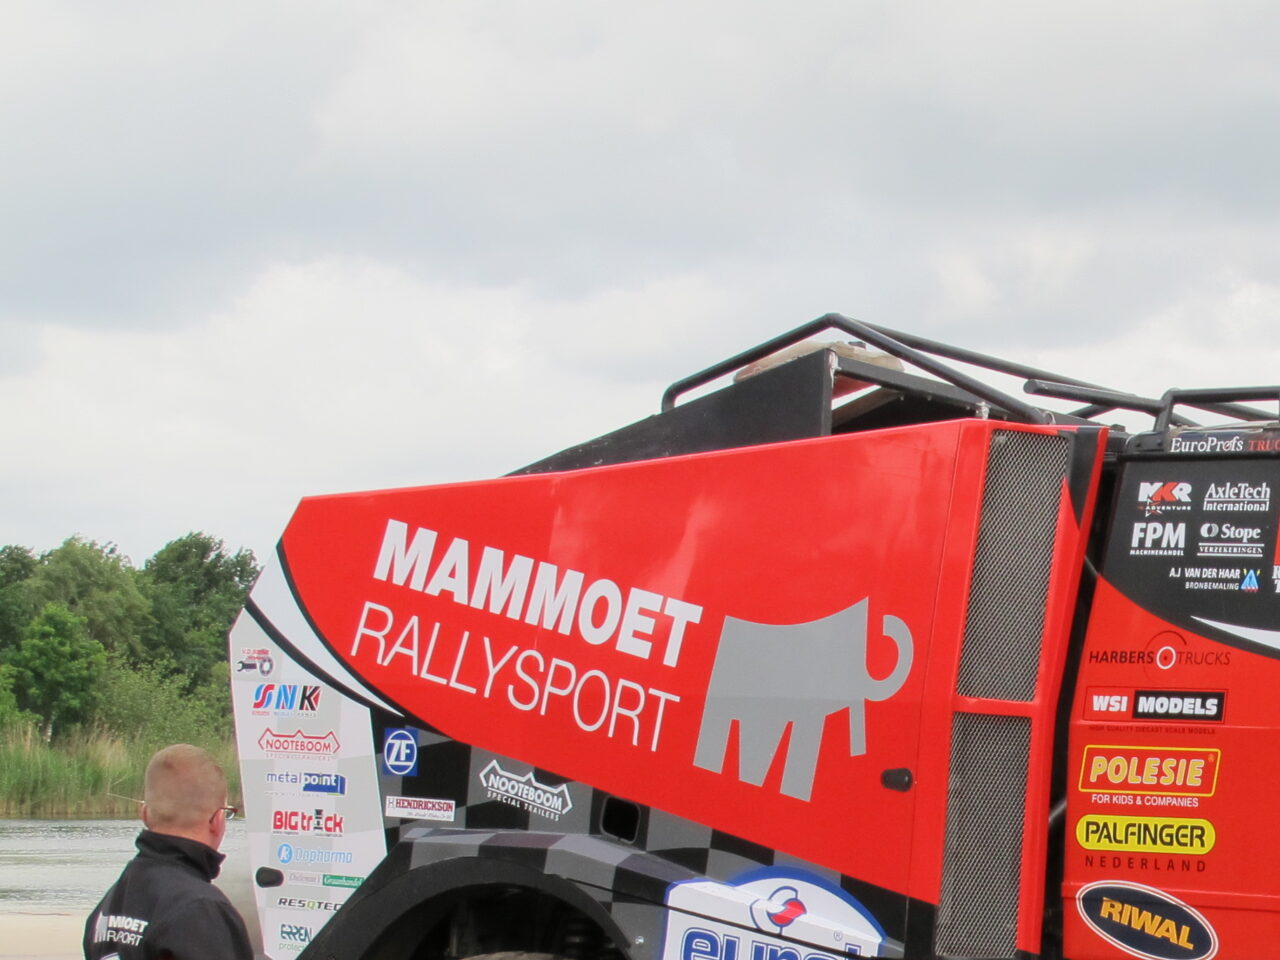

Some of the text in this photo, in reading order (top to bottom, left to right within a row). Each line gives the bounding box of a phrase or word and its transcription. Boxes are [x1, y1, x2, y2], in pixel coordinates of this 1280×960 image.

[1170, 436, 1244, 453] EuroProfs
[1204, 482, 1271, 499] AxleTech
[1202, 501, 1270, 512] International
[1131, 522, 1186, 548] FPM
[1220, 523, 1261, 543] Stope
[1184, 567, 1201, 578] VAN
[1201, 568, 1218, 579] DER
[1218, 568, 1241, 579] HAAR
[373, 518, 704, 668] MAMMOET
[1185, 581, 1240, 591] BRONBEMALING
[1088, 651, 1231, 665] HARBERS TRUCKS
[350, 601, 681, 752] RALLYSPORT
[1092, 695, 1218, 715] WSI MODELS
[265, 739, 332, 753] NOOTEBOOM
[388, 739, 412, 765] ZF
[1089, 755, 1205, 787] POLESIE
[488, 773, 562, 812] NOOTEBOOM
[1091, 794, 1111, 804] FOR
[1112, 794, 1134, 805] KIDS
[1144, 796, 1199, 808] COMPANIES
[396, 798, 454, 812] HENDRICKSON
[486, 790, 561, 822] SPECIAL TRAILERS
[1085, 821, 1206, 848] PALFINGER
[1085, 855, 1206, 872] NEDERLAND
[1100, 897, 1194, 950] RIWAL
